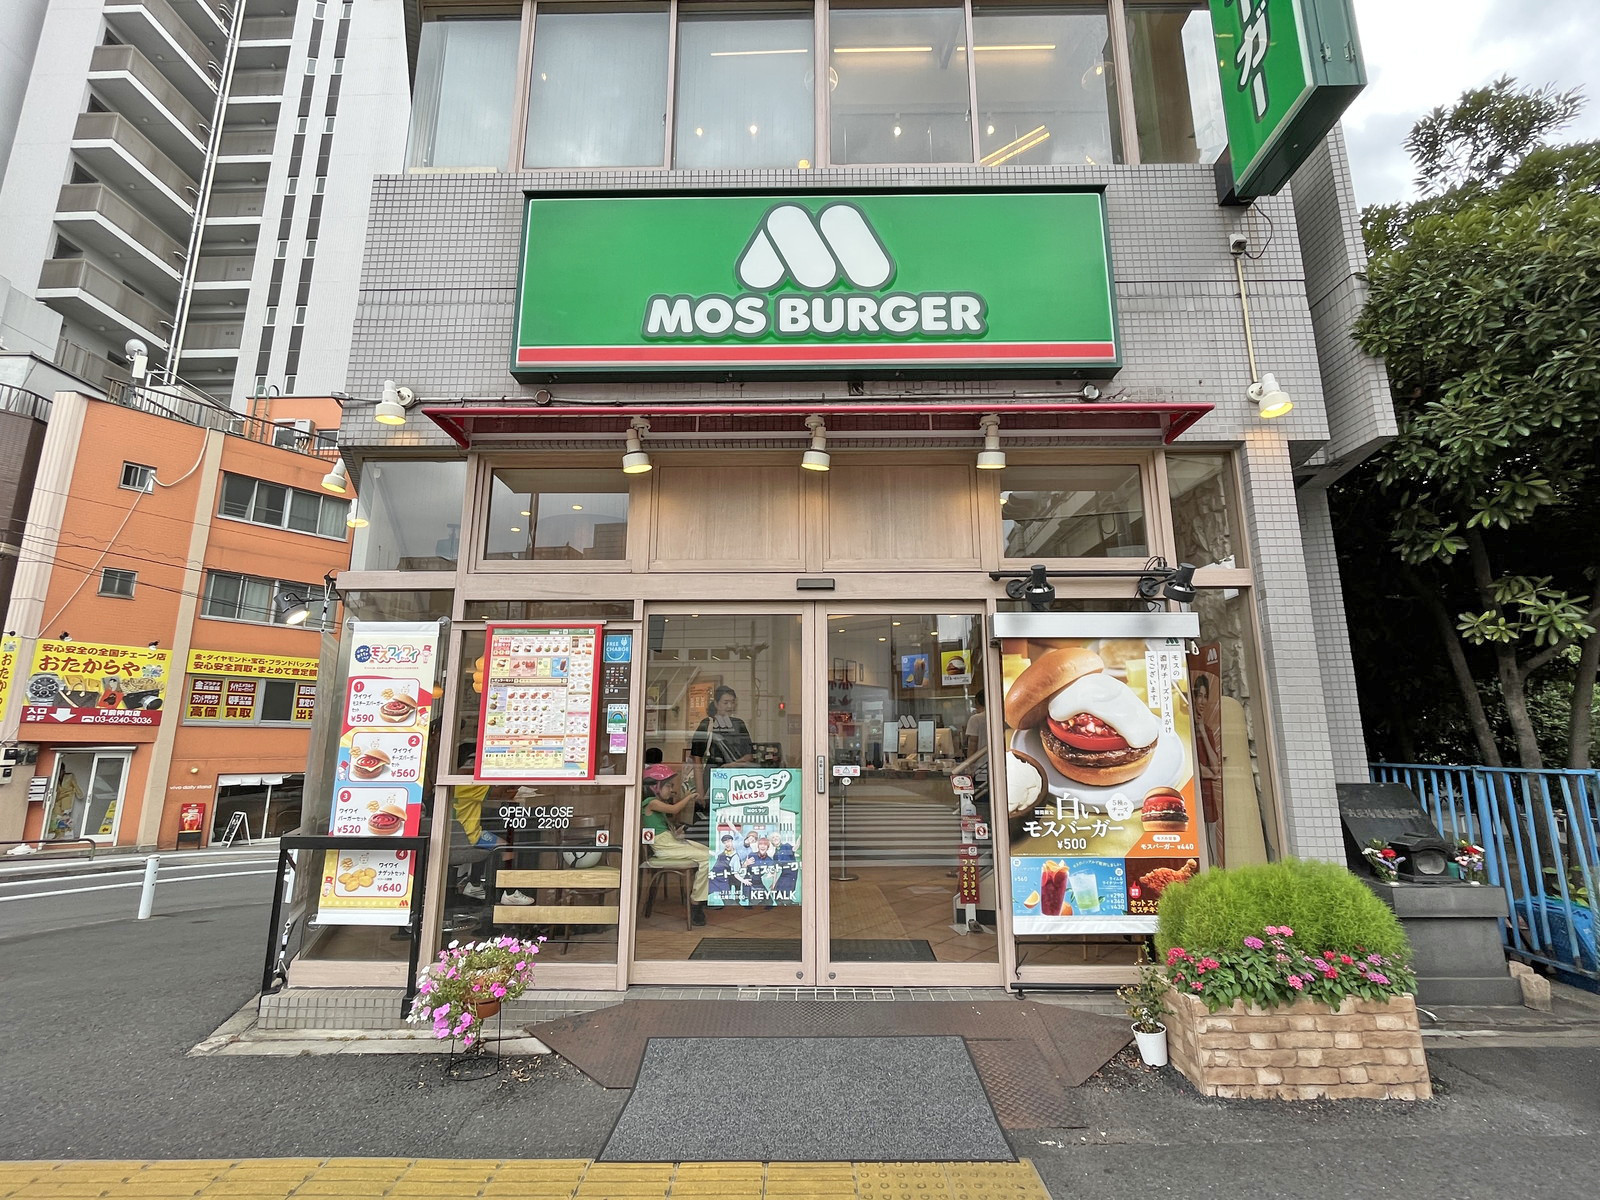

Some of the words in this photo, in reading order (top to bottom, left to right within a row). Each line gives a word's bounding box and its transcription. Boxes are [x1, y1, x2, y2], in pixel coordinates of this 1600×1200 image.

[646, 297, 768, 335] MOS
[778, 295, 982, 334] BURGER
[42, 643, 167, 661] 安心安全の全国チェーン店
[39, 655, 141, 677] おたからや
[1171, 654, 1180, 677] モスの
[0, 653, 12, 714] おたか
[1148, 655, 1159, 705] でございます。
[26, 707, 47, 715] 入口
[190, 706, 218, 718] 高価
[225, 706, 252, 718] 買取
[94, 715, 153, 725] 03-6240-3036
[350, 714, 375, 723] ¥590
[390, 768, 416, 778] ¥560
[734, 774, 787, 791] MOSラジ
[498, 806, 531, 818] OPEN
[534, 806, 574, 818] CLOSE
[1056, 792, 1101, 820] 白い
[337, 824, 361, 834] ¥520
[503, 818, 527, 829] 7:00
[537, 817, 570, 829] 22:00
[1022, 819, 1125, 838] モスバーガー
[1057, 837, 1087, 850] ¥500
[377, 883, 402, 893] ¥640
[750, 890, 797, 900] KEYTALK
[1130, 899, 1146, 907] ホット
